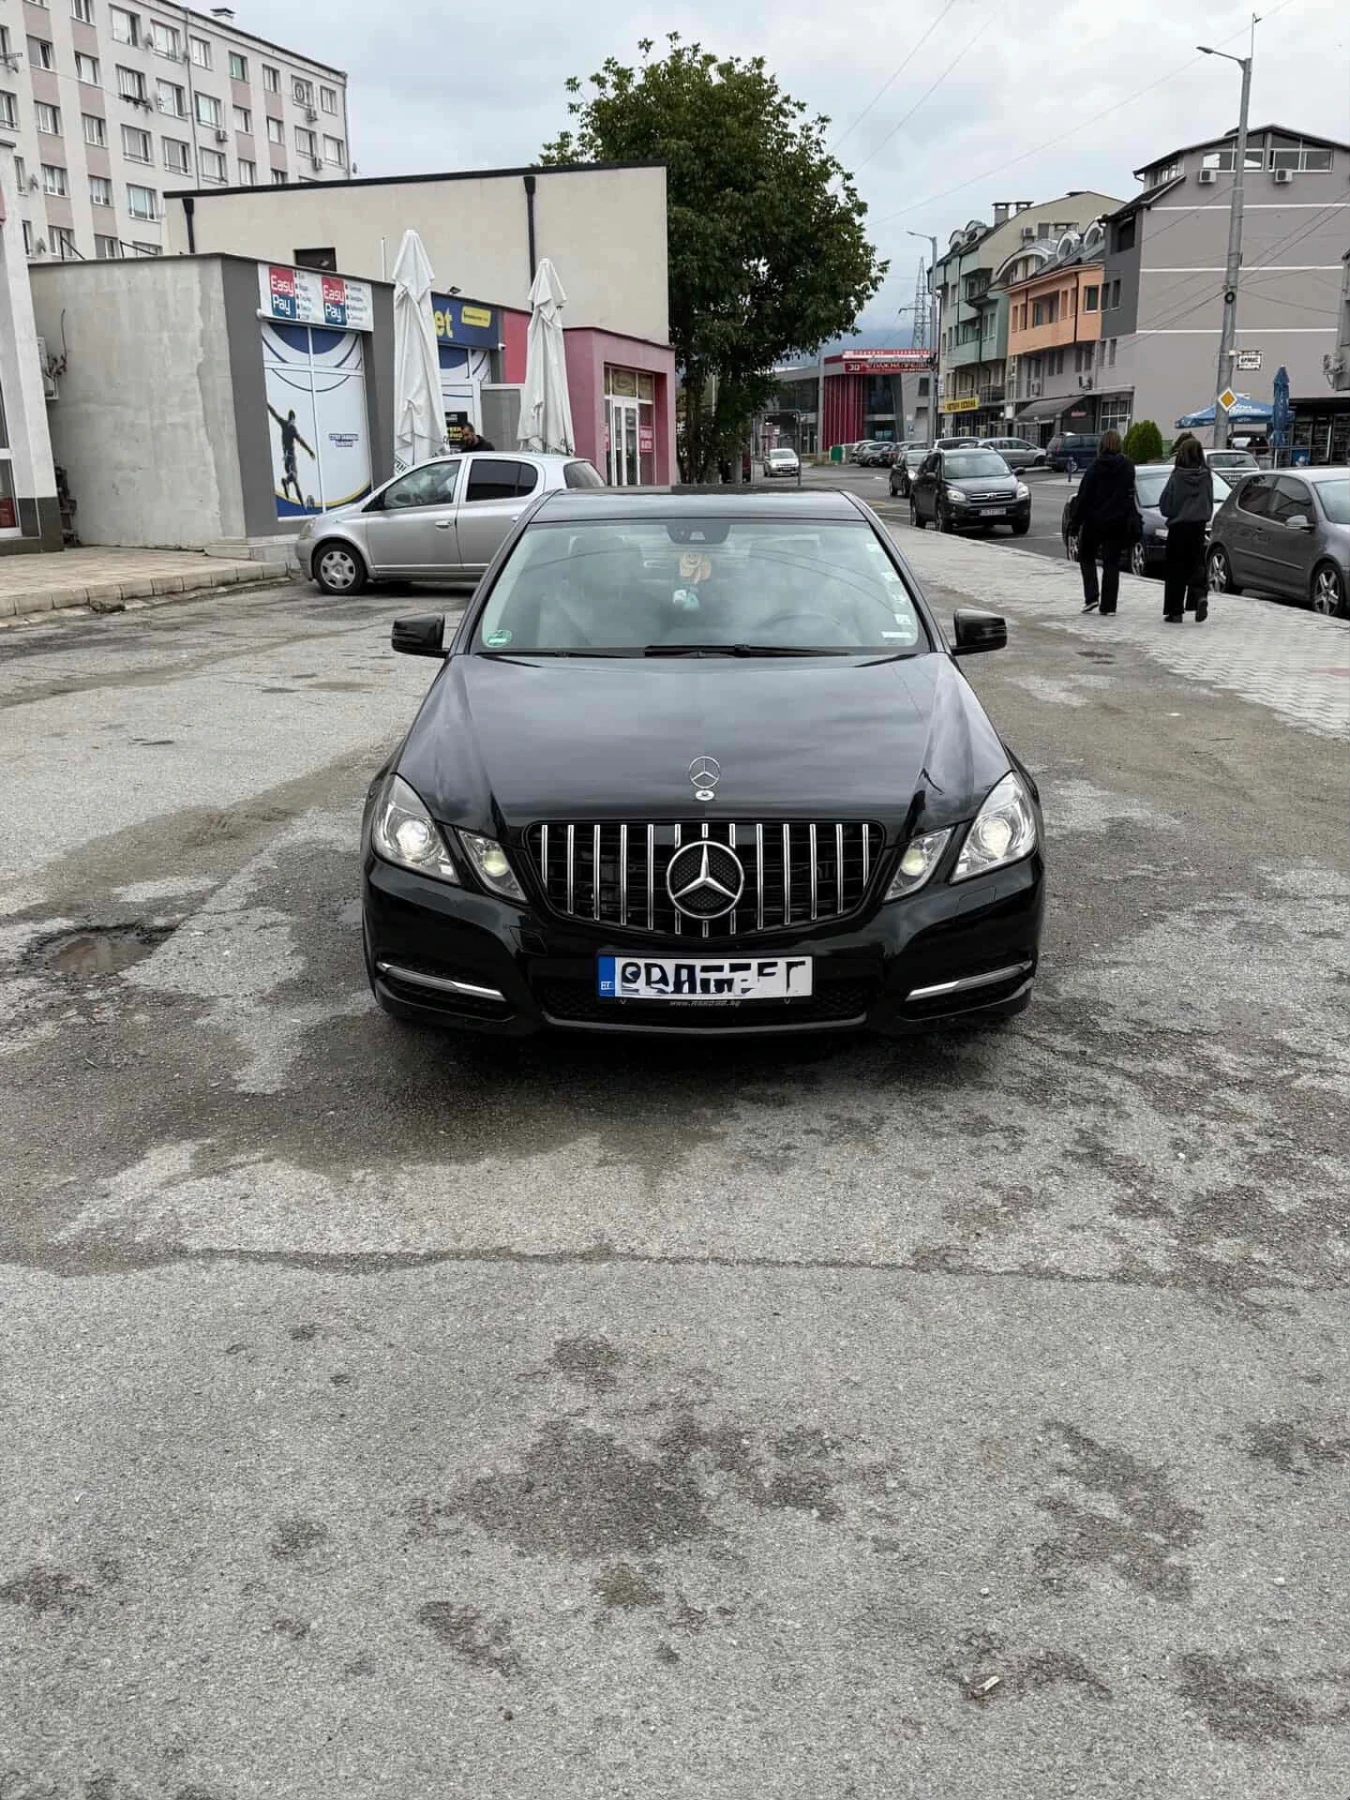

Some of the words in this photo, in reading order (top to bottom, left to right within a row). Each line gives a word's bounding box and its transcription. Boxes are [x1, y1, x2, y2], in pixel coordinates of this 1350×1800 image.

[270, 275, 294, 297] Easy
[323, 284, 344, 305] Easy
[272, 294, 291, 314] Pay
[325, 302, 342, 322] Pay
